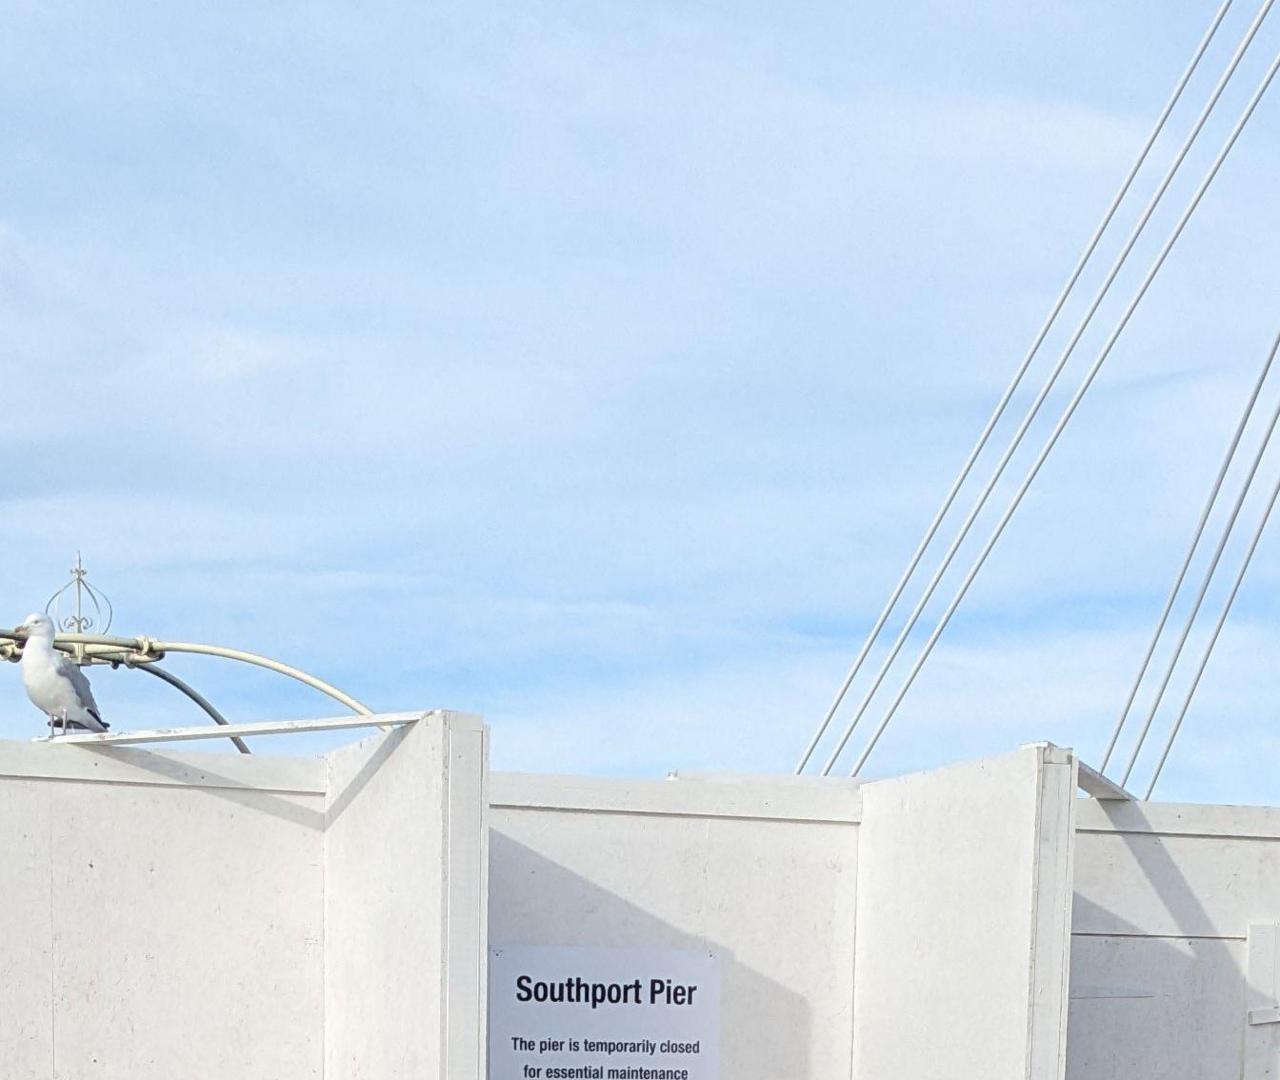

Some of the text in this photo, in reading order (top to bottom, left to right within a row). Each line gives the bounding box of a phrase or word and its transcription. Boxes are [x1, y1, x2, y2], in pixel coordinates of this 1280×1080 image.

[517, 976, 697, 1009] Southport Pier
[511, 1037, 699, 1055] The pier is temporarily closed
[524, 1065, 688, 1080] for essential maintenance
